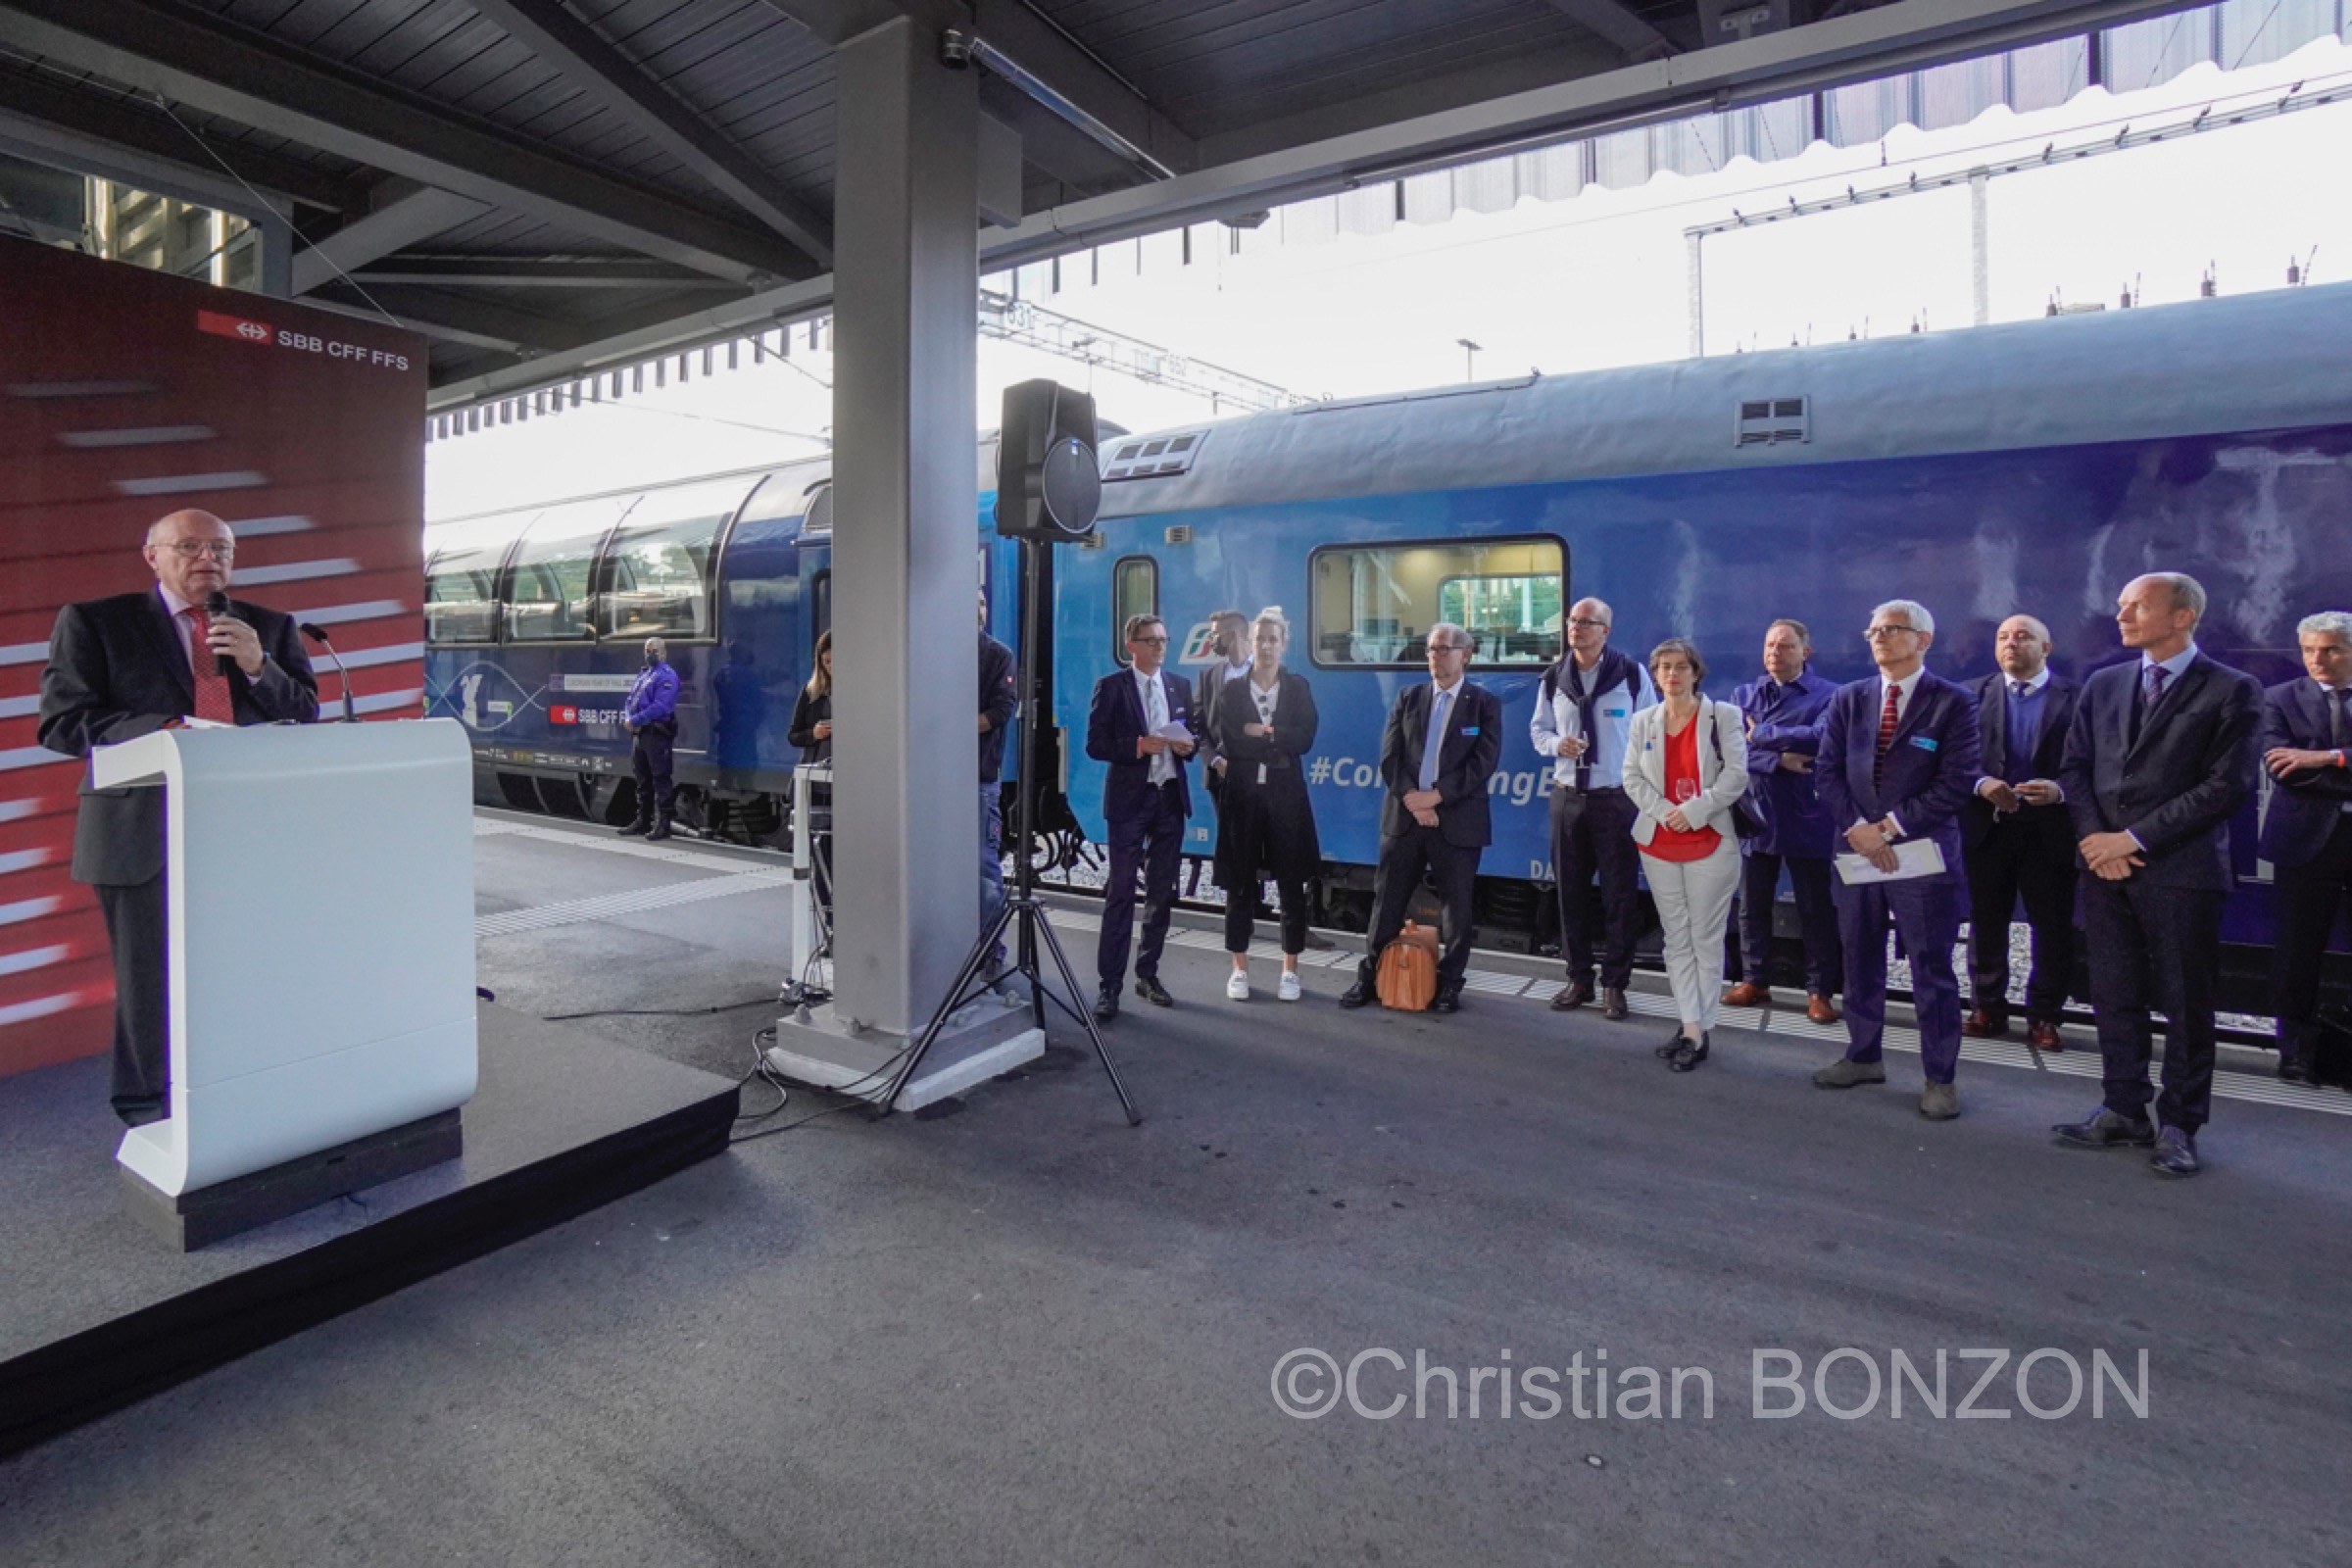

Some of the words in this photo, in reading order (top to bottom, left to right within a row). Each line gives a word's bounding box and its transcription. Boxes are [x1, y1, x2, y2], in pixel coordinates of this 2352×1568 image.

[277, 330, 322, 353] SBB
[327, 341, 368, 362] CFF
[371, 350, 409, 370] FFS
[578, 709, 598, 724] SBB
[599, 709, 618, 724] CFF
